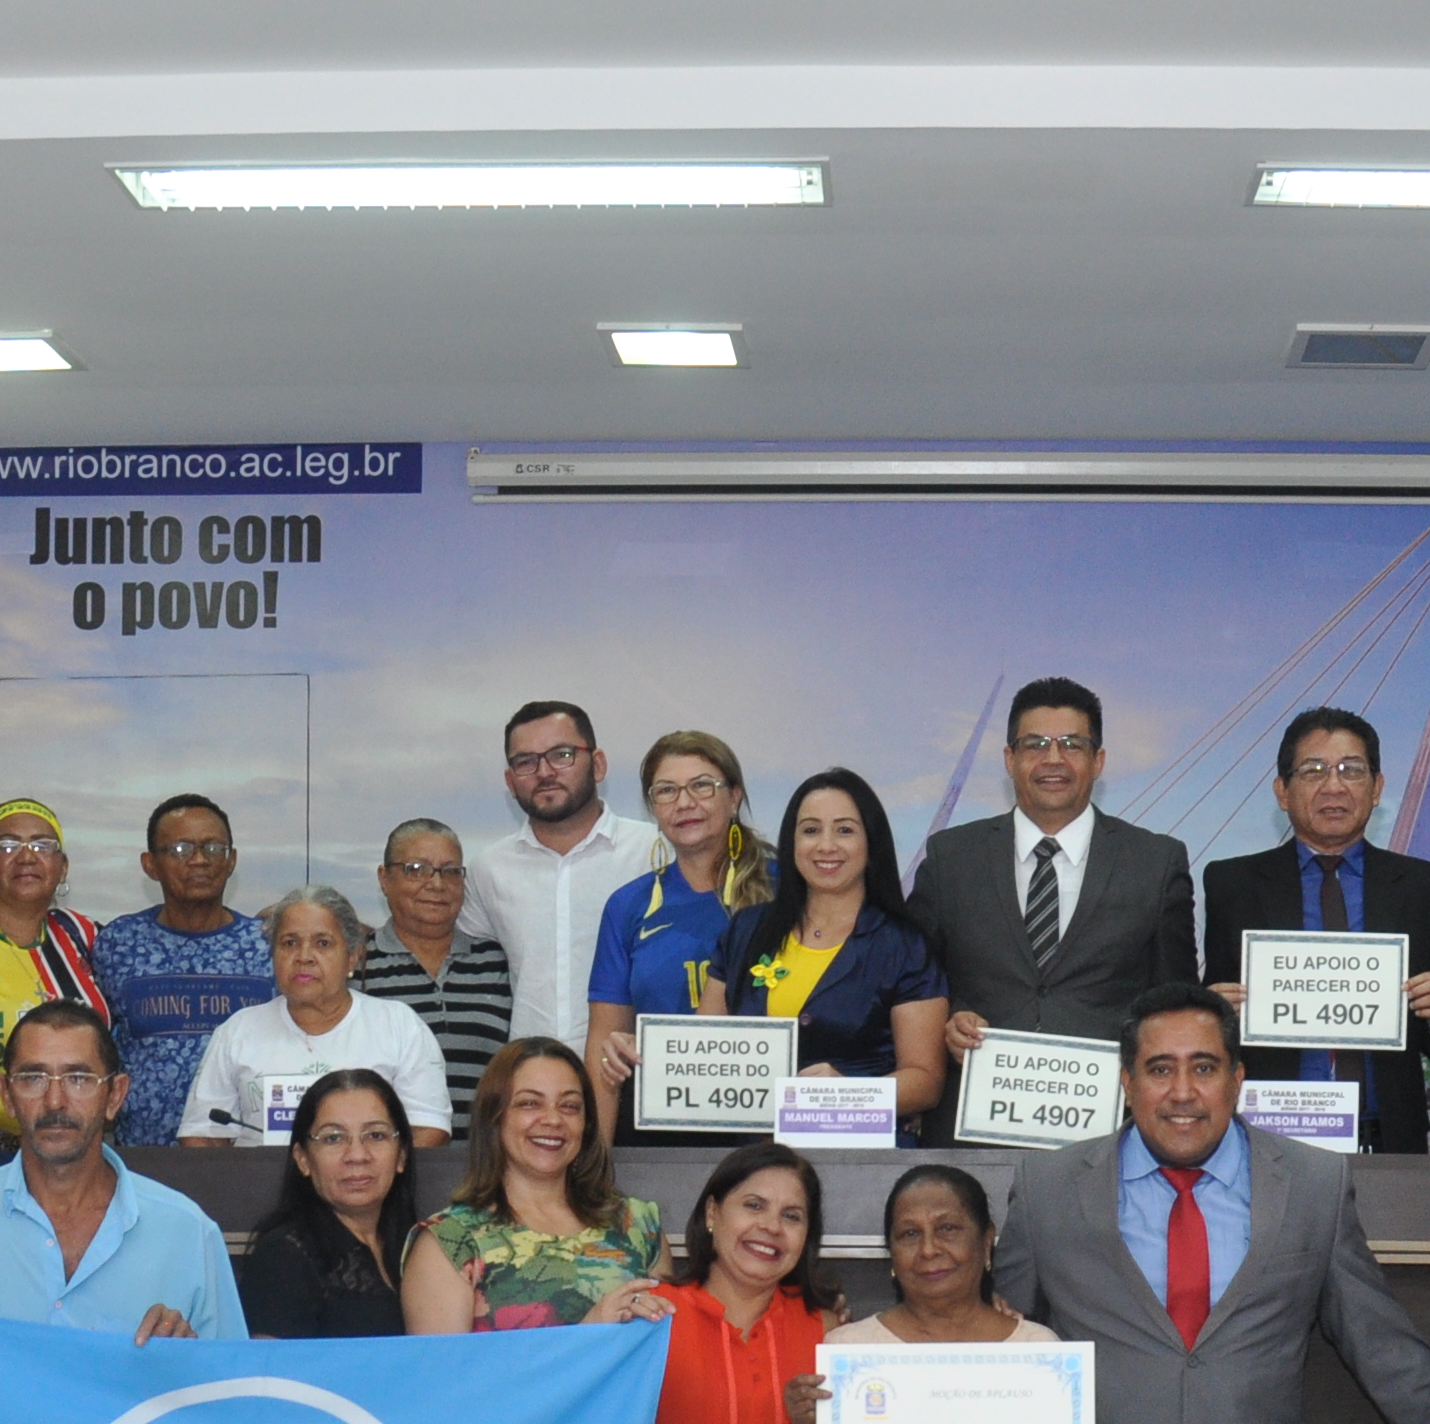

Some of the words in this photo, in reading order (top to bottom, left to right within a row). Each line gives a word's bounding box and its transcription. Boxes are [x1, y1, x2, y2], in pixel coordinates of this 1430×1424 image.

[526, 463, 551, 474] CSR
[29, 506, 183, 565] Junto
[198, 513, 323, 565] com
[72, 580, 106, 631] o
[120, 569, 280, 636] povo!
[1273, 955, 1298, 970] EU
[1303, 955, 1361, 971] APOIO
[1366, 956, 1380, 971] O
[1272, 979, 1351, 993] PARECER
[1355, 979, 1381, 993] DO
[199, 995, 231, 1015] FOR
[1273, 1002, 1308, 1025] PL
[1315, 1003, 1380, 1026] 4907
[665, 1039, 689, 1054] EU
[694, 1039, 751, 1055] APOIO
[755, 1040, 770, 1056] O
[665, 1063, 741, 1077] PARECER
[745, 1063, 770, 1078] DO
[994, 1053, 1020, 1069] EU
[1023, 1056, 1081, 1075] APOIO
[1086, 1062, 1100, 1076] O
[800, 1086, 836, 1095] CÂMARA
[838, 1087, 884, 1095] MUNICIPAL
[991, 1076, 1069, 1096] PARECER
[1073, 1083, 1099, 1098] DO
[1261, 1089, 1297, 1098] CÂMARA
[1299, 1090, 1345, 1099] MUNICIPAL
[666, 1086, 701, 1108] PL
[707, 1087, 770, 1109] 4907
[784, 1112, 835, 1123] MANUEL
[837, 1112, 888, 1124] MARCOS
[989, 1099, 1024, 1123] PL
[1031, 1104, 1096, 1129] 4907
[1250, 1115, 1299, 1127] JAKSON
[1302, 1116, 1345, 1127] RAMOS
